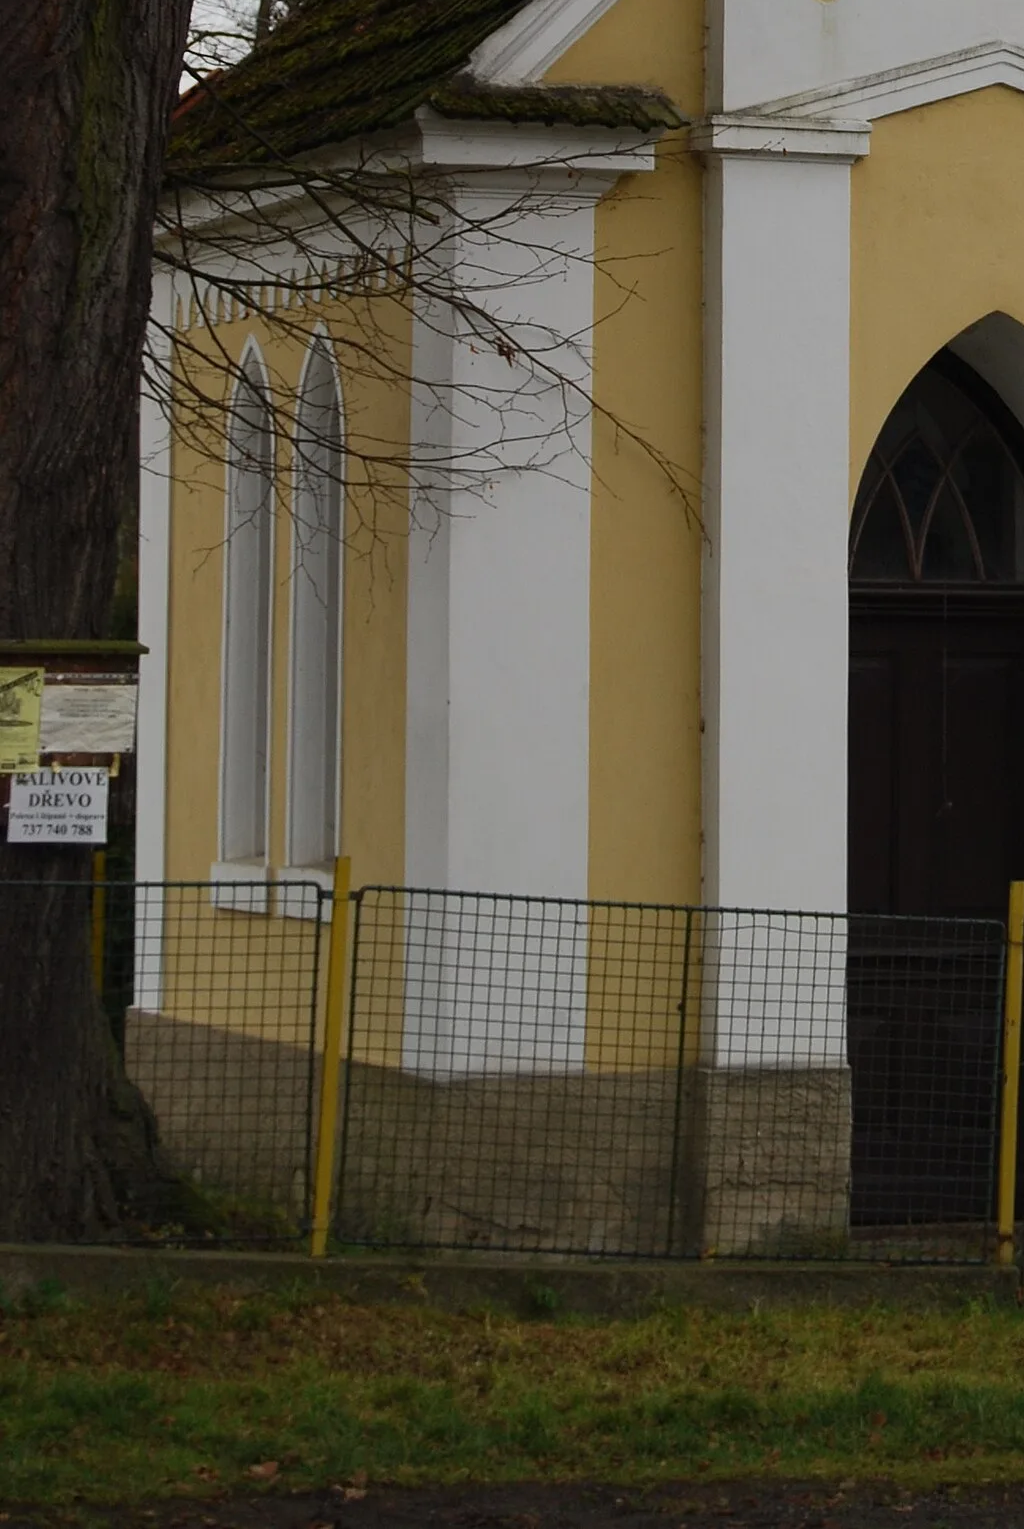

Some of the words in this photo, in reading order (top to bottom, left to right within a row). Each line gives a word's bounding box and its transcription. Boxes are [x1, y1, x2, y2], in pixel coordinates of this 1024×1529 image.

[28, 790, 92, 808] DŘEVO
[22, 824, 42, 836] 737
[46, 824, 68, 836] 740
[71, 824, 94, 836] 788
